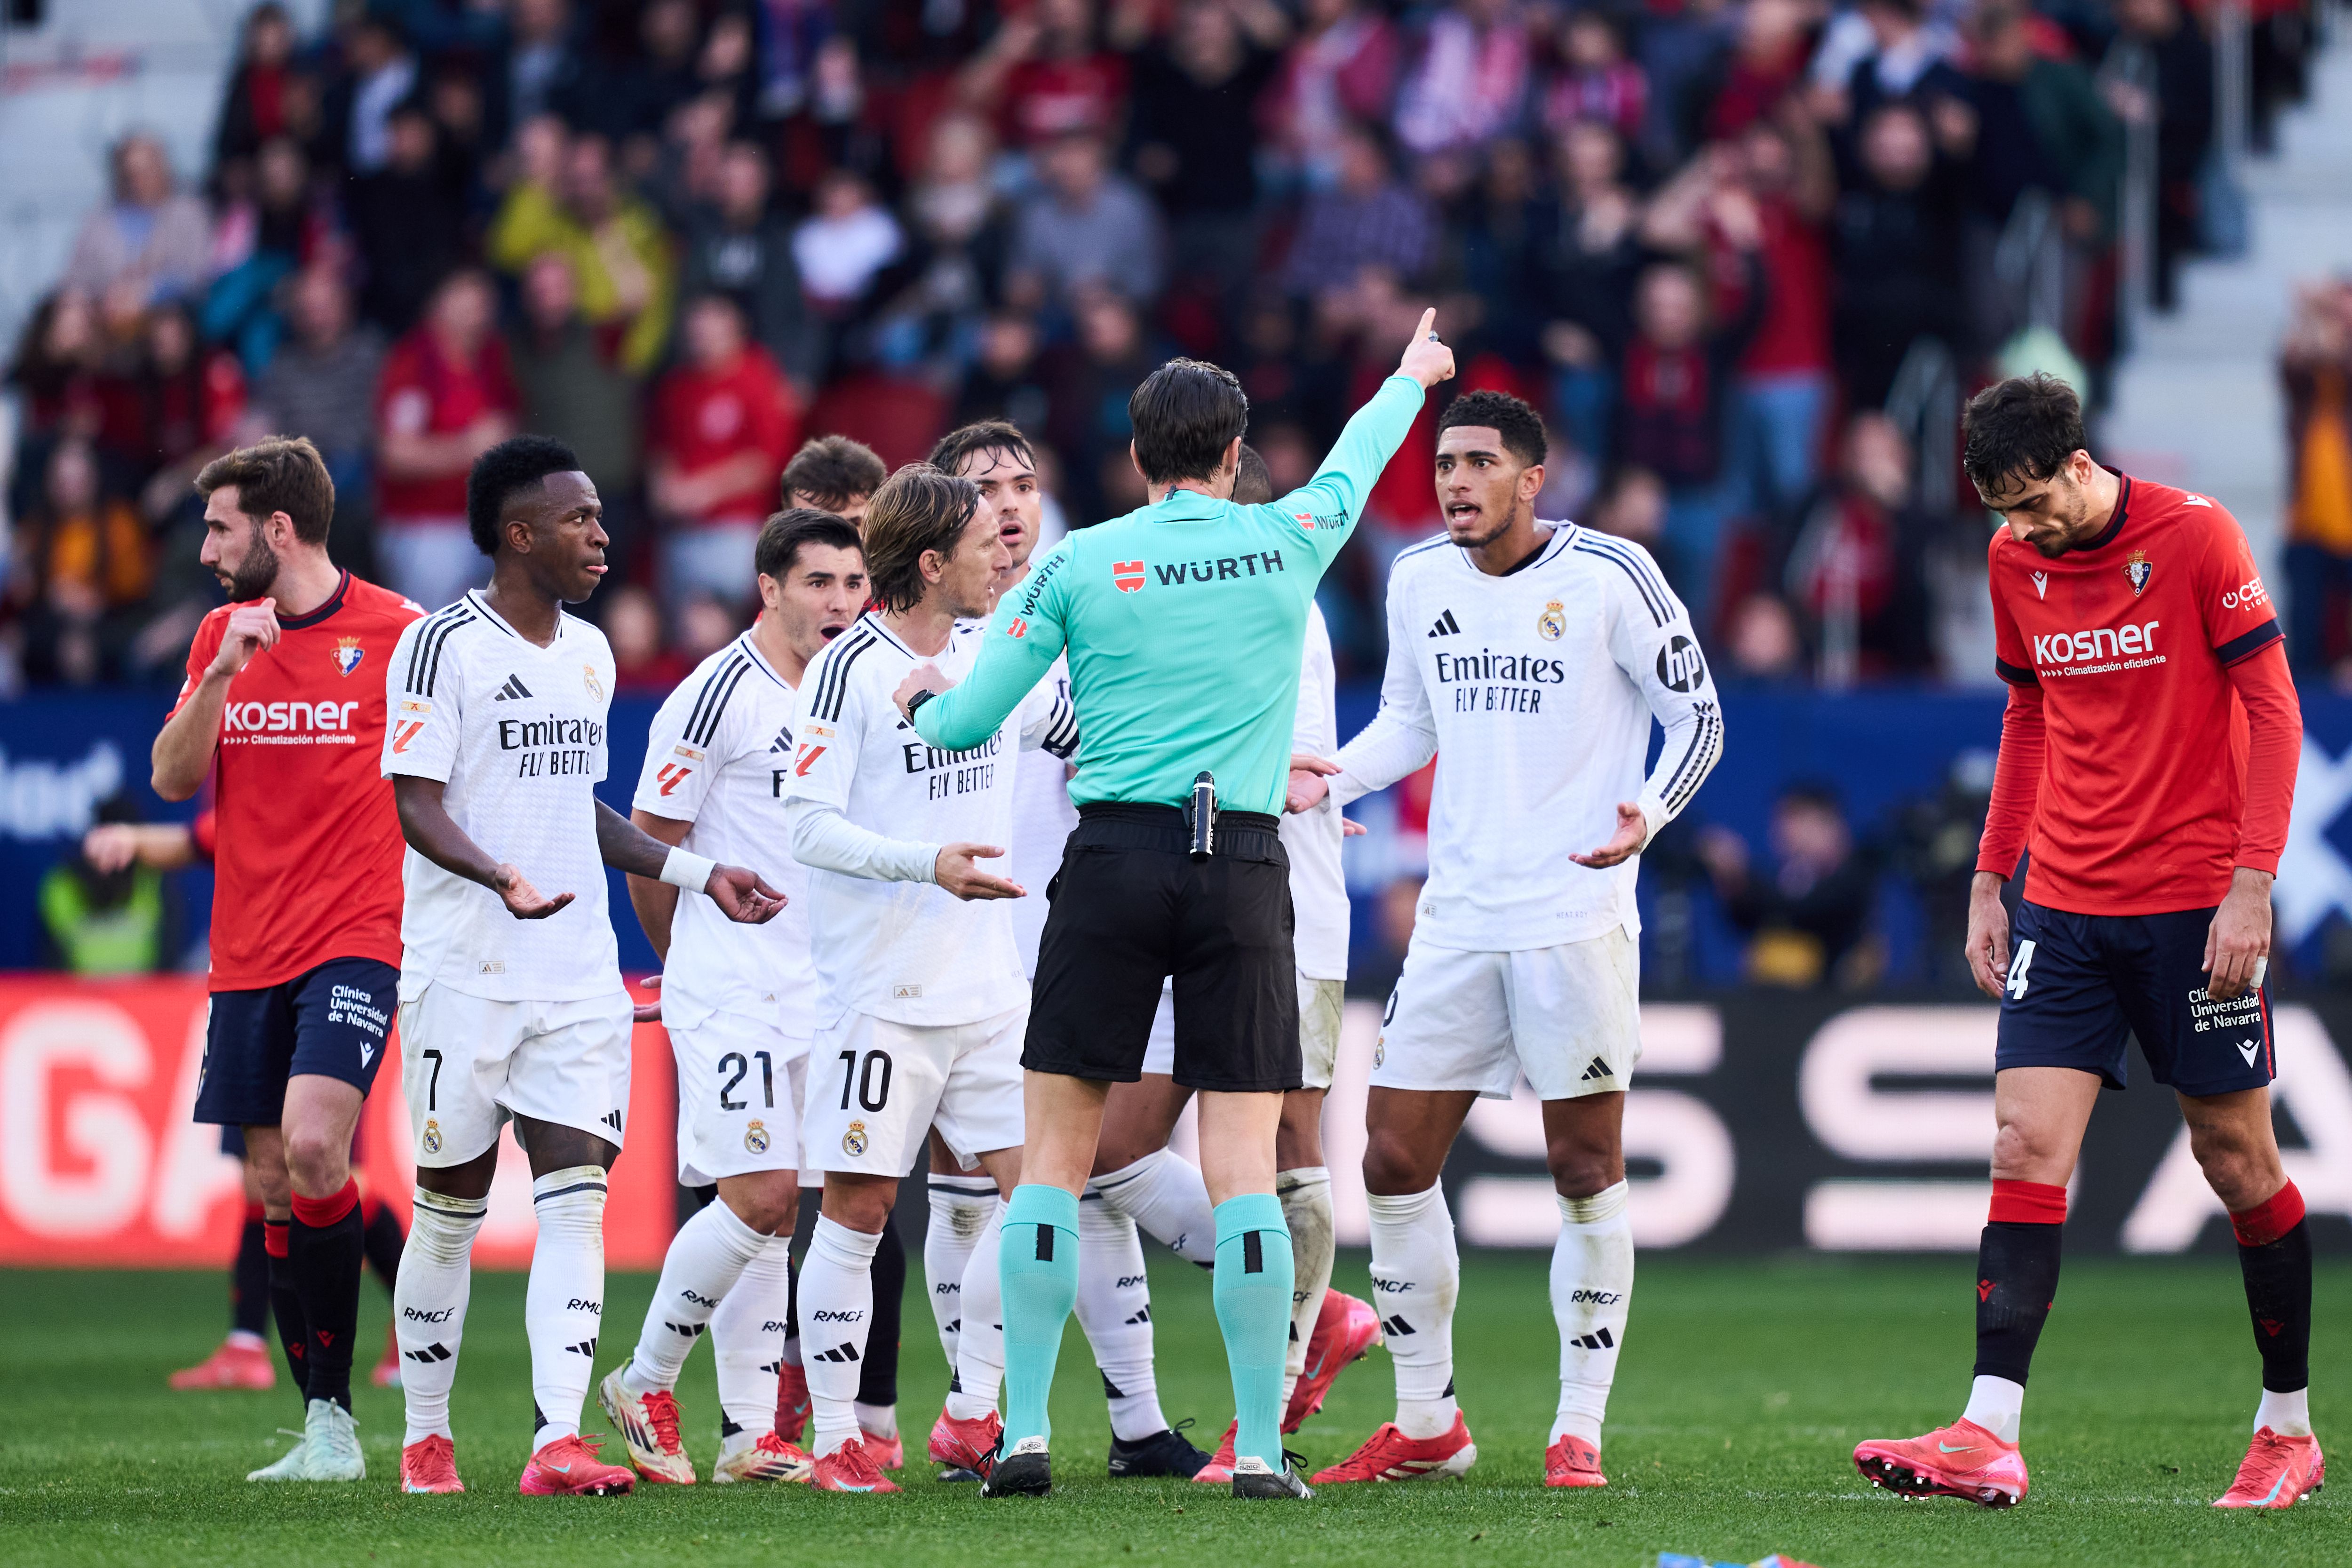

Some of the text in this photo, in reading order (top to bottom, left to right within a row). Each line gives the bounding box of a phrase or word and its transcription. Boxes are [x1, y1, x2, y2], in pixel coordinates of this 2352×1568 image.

[1154, 550, 1284, 585] WÜRTH
[1020, 555, 1065, 616] WÜRTH
[1435, 648, 1564, 684] Emirates
[1664, 637, 1700, 692] hp
[2064, 655, 2166, 676] Climatización eficiente
[1456, 687, 1541, 713] FLY BETTER
[251, 734, 356, 745] Climatización eficiente
[498, 713, 603, 749] Emirates
[519, 750, 589, 777] FLY BETTE
[930, 772, 950, 800] FLY
[2007, 939, 2036, 1000] 4
[332, 985, 371, 1004] Clínica
[2191, 993, 2259, 1018] Universidad
[328, 1010, 383, 1038] de Navarra
[330, 997, 388, 1026] Universidad
[2194, 1012, 2261, 1032] de Navarra
[423, 1049, 443, 1111] 7
[718, 1051, 774, 1112] 21
[839, 1050, 892, 1112] 10
[937, 1283, 961, 1294] RM
[1571, 1290, 1622, 1305] RMCF
[404, 1307, 455, 1323] RMCF
[567, 1298, 602, 1317] RMC
[813, 1310, 864, 1321] RMCF
